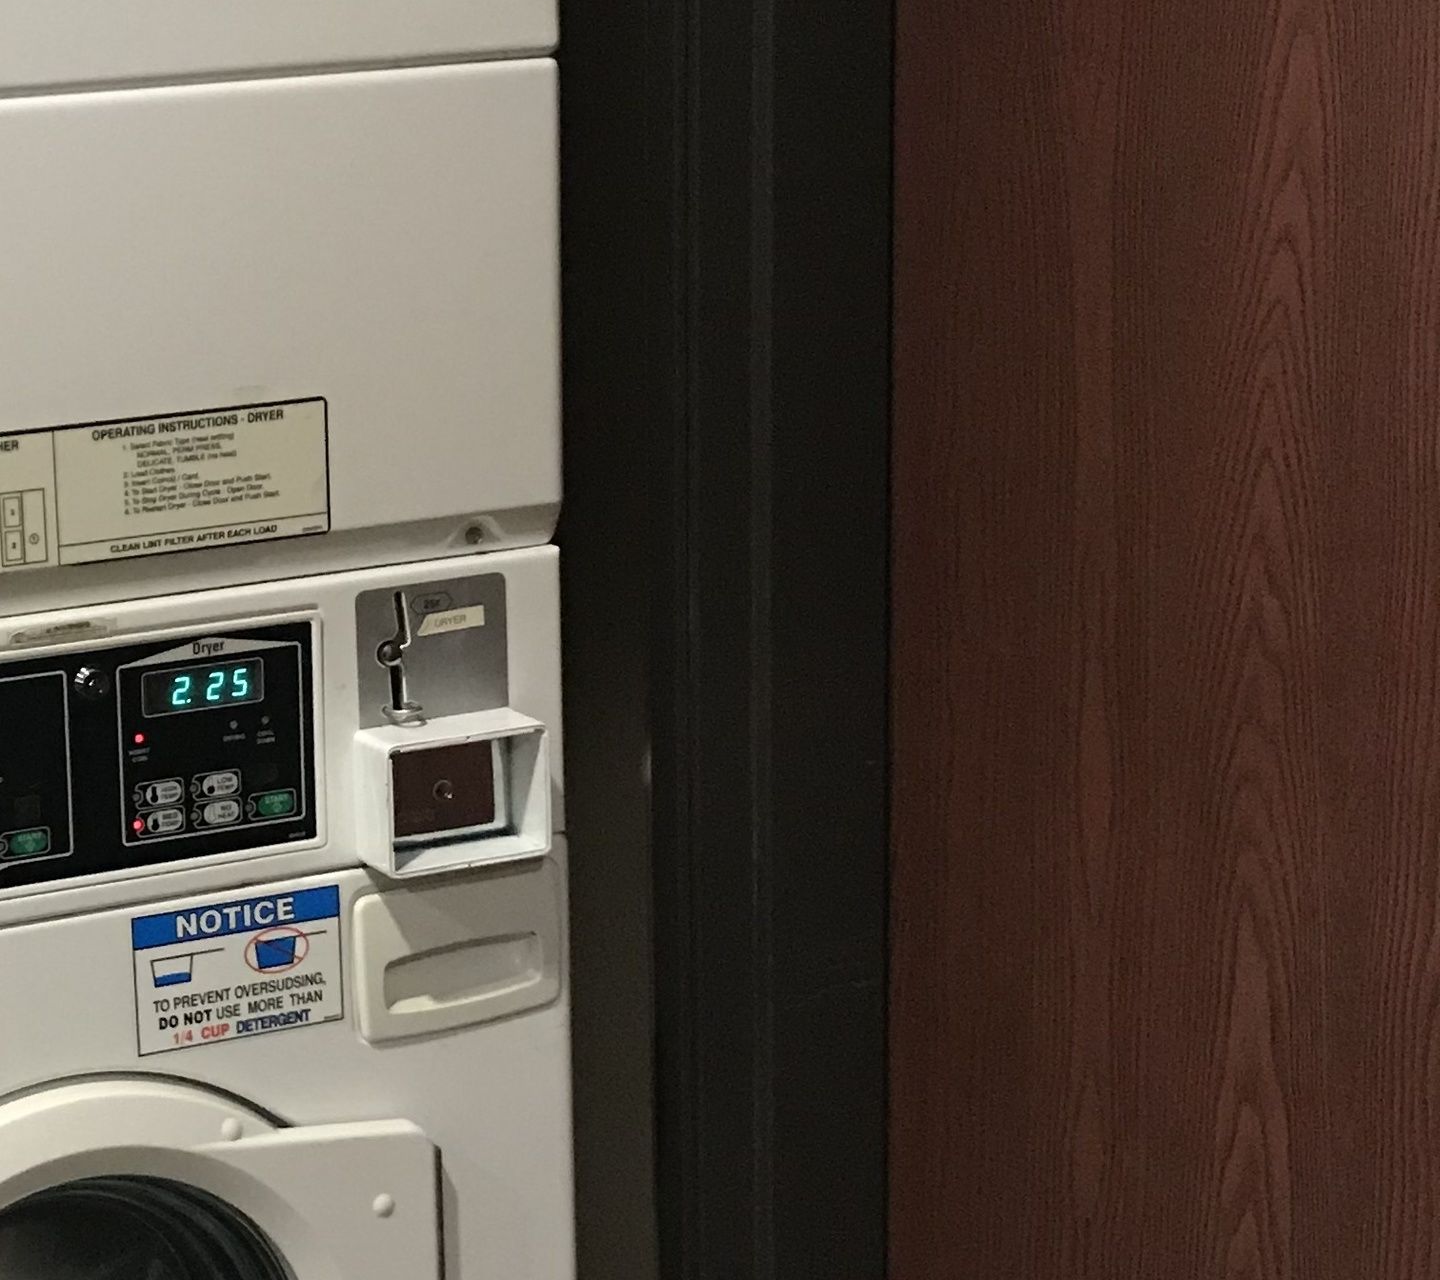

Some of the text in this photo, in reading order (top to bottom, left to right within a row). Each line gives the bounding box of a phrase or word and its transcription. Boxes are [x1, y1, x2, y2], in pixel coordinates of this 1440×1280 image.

[92, 423, 154, 441] OPERATING
[158, 414, 238, 433] INSTRUCTIONS
[247, 408, 283, 423] DRYER
[110, 541, 139, 553] CLEAN
[195, 531, 225, 542] AFTER
[227, 527, 252, 538] EACH
[253, 524, 277, 535] LOAD
[192, 642, 225, 656] Dryer
[176, 897, 294, 938] NOTICE
[153, 1000, 170, 1013] TO
[174, 989, 231, 1009] PREVENT
[160, 990, 323, 1030] DO NOT USE MORE THAN
[173, 1032, 193, 1045] 1/4
[201, 1023, 230, 1039] CUP
[236, 1009, 310, 1034] DETERGENT
